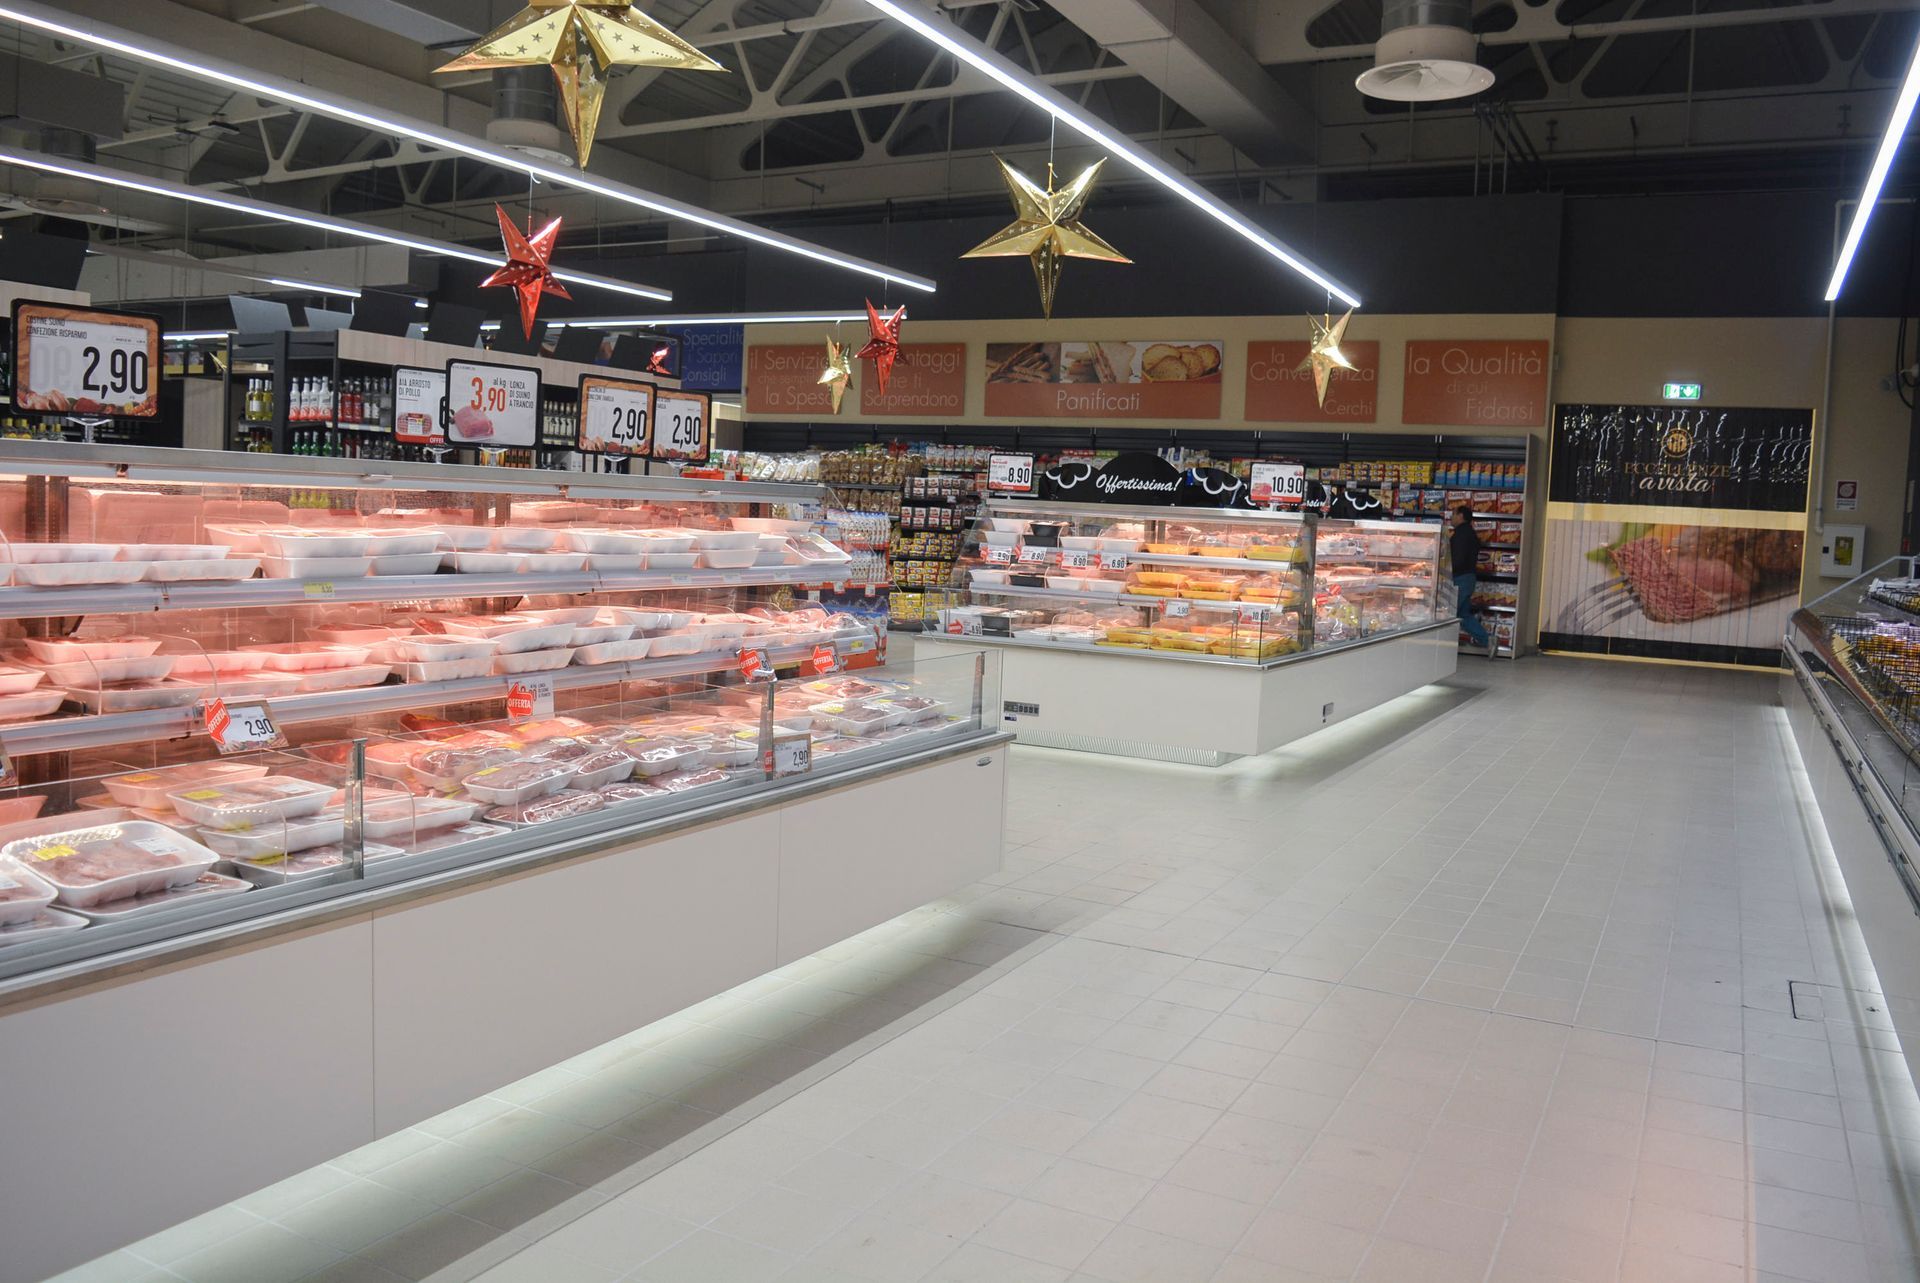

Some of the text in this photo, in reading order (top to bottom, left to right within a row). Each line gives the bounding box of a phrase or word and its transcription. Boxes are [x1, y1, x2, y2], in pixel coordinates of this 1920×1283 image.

[26, 325, 88, 340] CONFEZIONE RISPARMIO
[893, 348, 960, 374] ntaggi
[1271, 345, 1286, 364] la
[1408, 345, 1542, 376] la Qualità
[82, 346, 148, 400] 2,90
[1250, 361, 1374, 382] Conveenza
[408, 380, 431, 390] ARROSTO
[493, 378, 507, 388] al kg
[509, 380, 526, 390] LONZA
[1466, 381, 1489, 395] cui
[405, 388, 421, 398] POLLO
[470, 377, 506, 412] 3,90
[509, 391, 531, 400] DI SUINO
[766, 385, 780, 406] la
[864, 388, 959, 412] Sorprendono
[1056, 390, 1140, 411] Panificati
[513, 401, 534, 409] TRANCIO
[1323, 399, 1374, 416] Cerchi
[1465, 396, 1535, 420] Fidarsi
[611, 407, 647, 444] 2,90
[672, 414, 701, 449] 2,90
[1008, 467, 1030, 484] 8,90
[1623, 462, 1732, 478] ECCELLENZE
[1095, 473, 1182, 494] Offertissima!
[1272, 476, 1303, 494] 10,90
[1639, 472, 1711, 493] a vista
[740, 656, 758, 669] OFFERTA
[813, 655, 833, 666] OFFERTA
[508, 698, 531, 709] OFFERTA
[208, 707, 227, 734] OFFERTA
[244, 718, 275, 738] 2,90
[793, 750, 809, 768] 2,90
